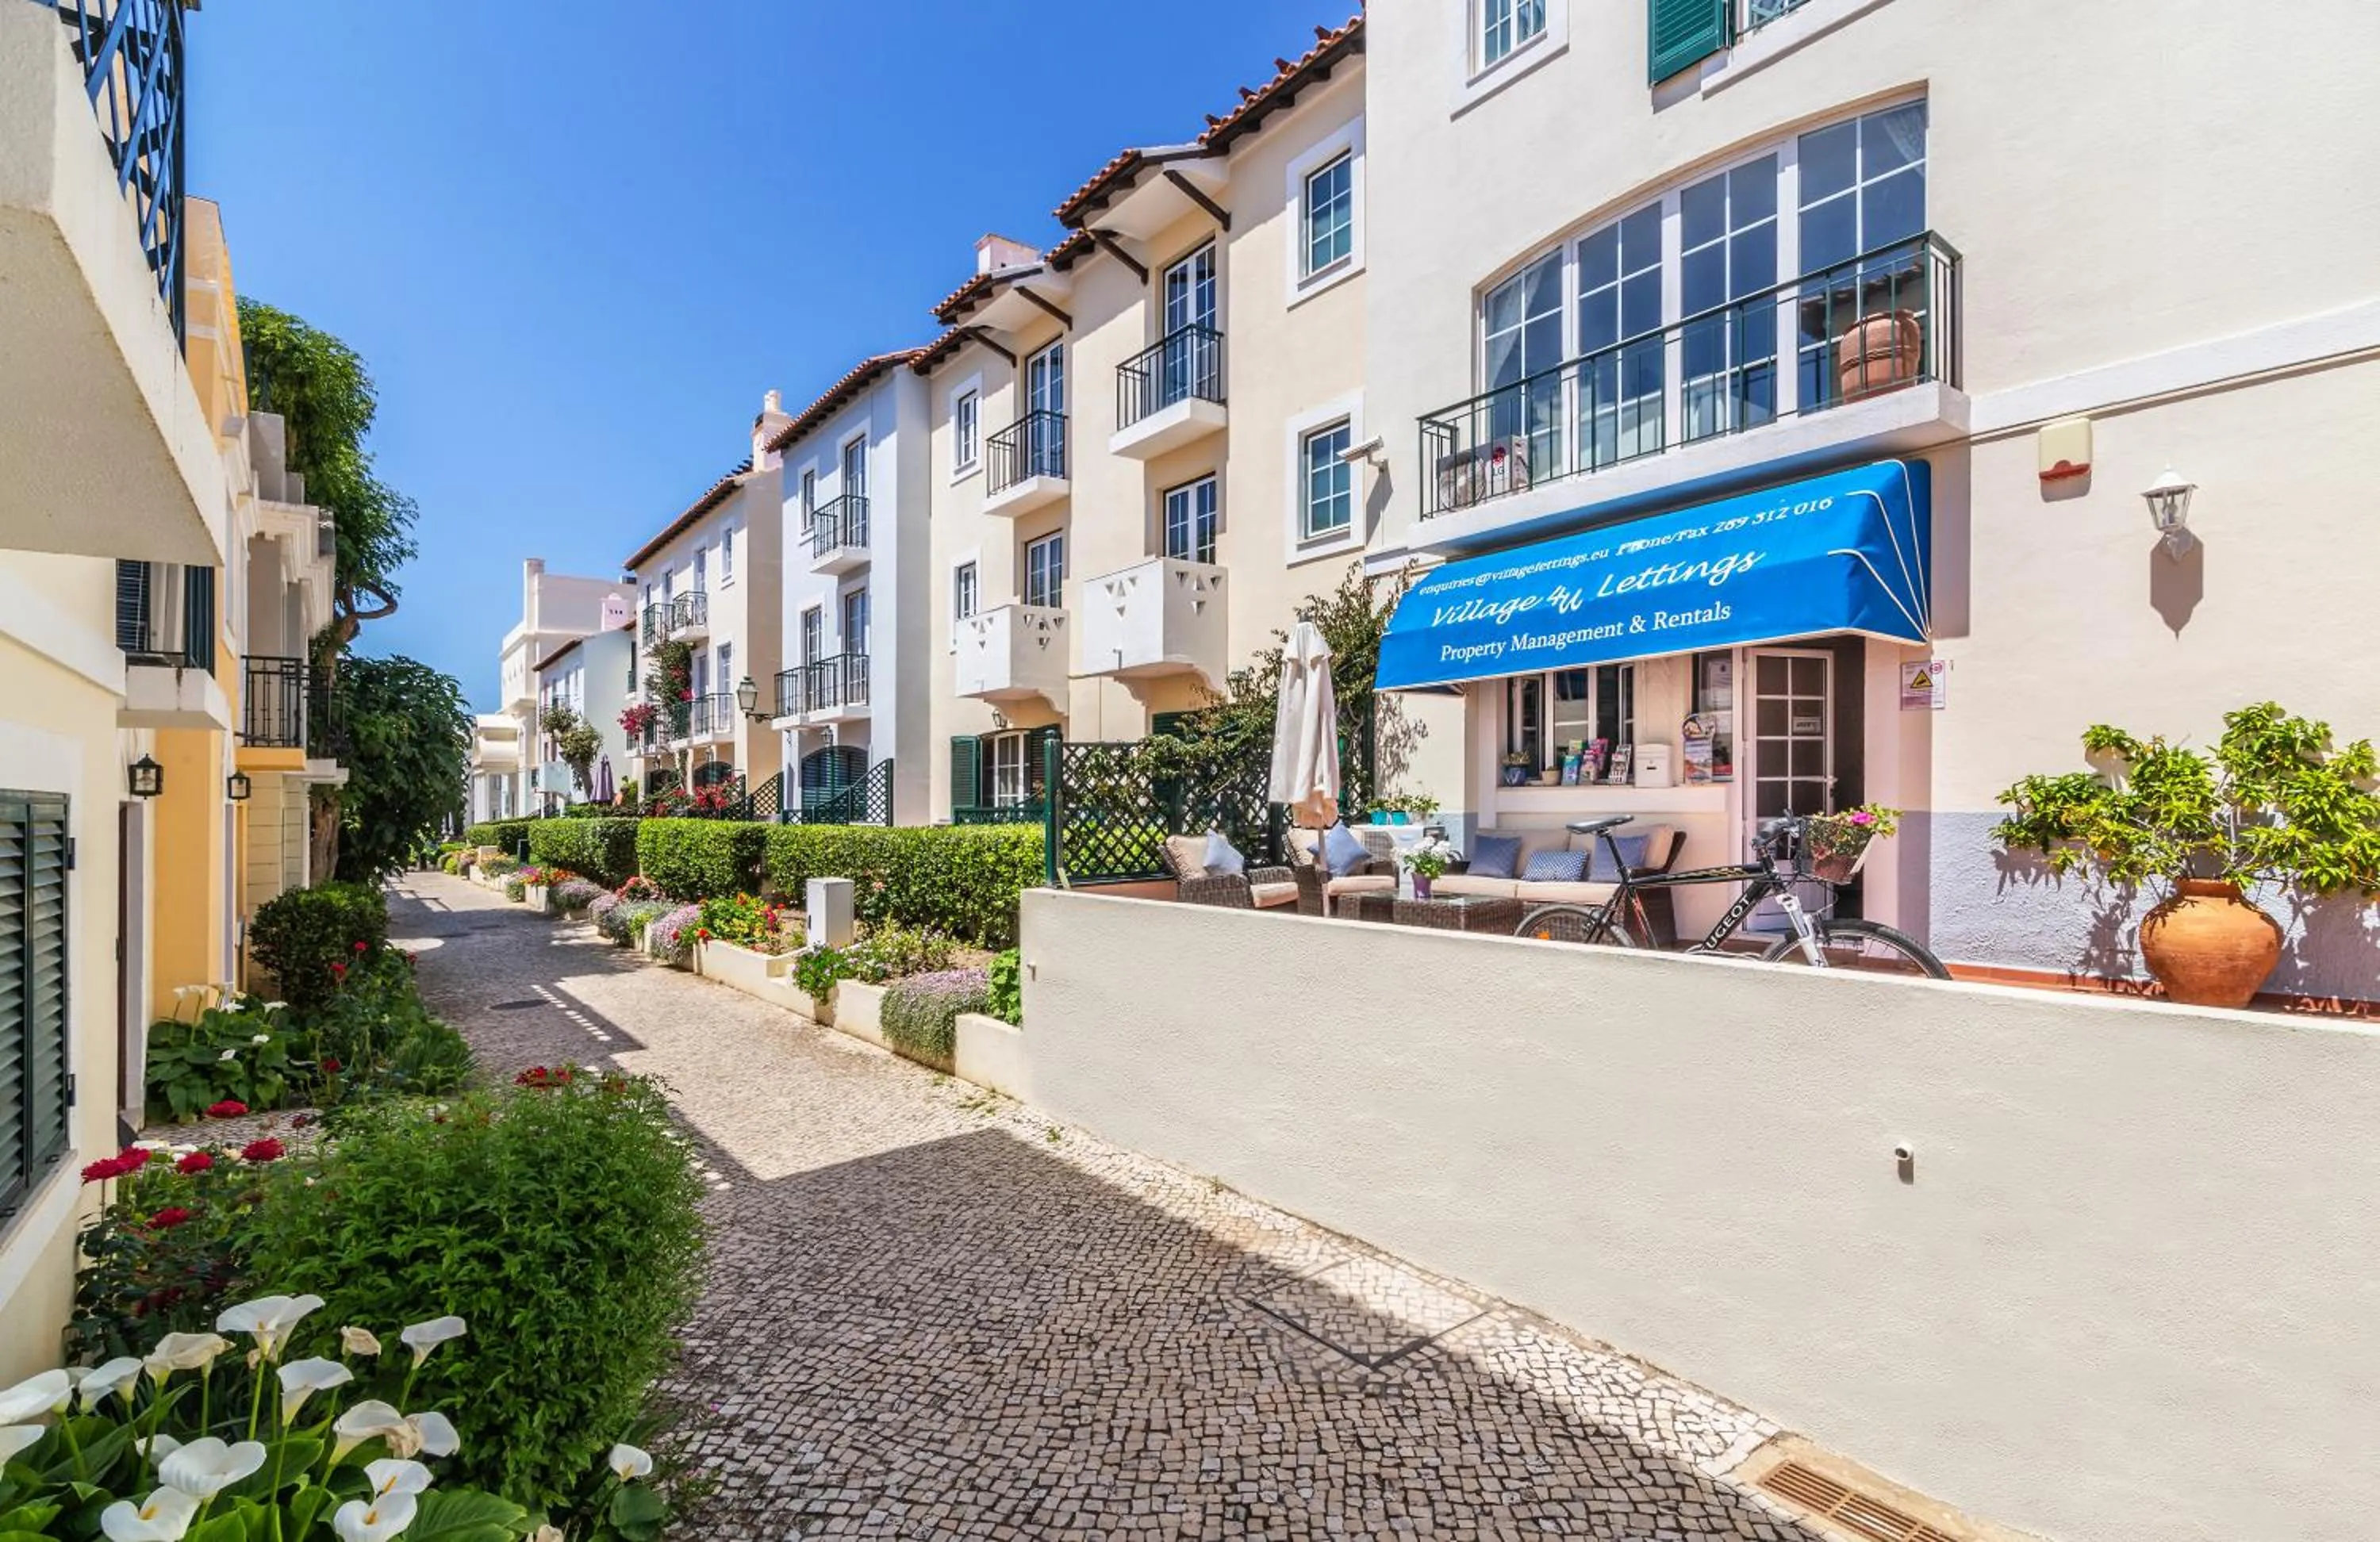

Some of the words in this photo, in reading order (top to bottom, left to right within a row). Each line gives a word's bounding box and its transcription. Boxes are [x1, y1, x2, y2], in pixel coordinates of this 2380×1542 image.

[1491, 466, 1505, 476] LG
[1712, 516, 1749, 534] 289
[1752, 508, 1790, 525] 312
[1794, 497, 1834, 516] 016
[1430, 596, 1544, 627] Village
[1596, 550, 1767, 597] Lettings
[1440, 641, 1507, 664] Property
[1510, 621, 1624, 650] Management
[1629, 615, 1647, 635] &
[1652, 600, 1731, 631] Rentals
[1706, 894, 1750, 949] UGEOT
